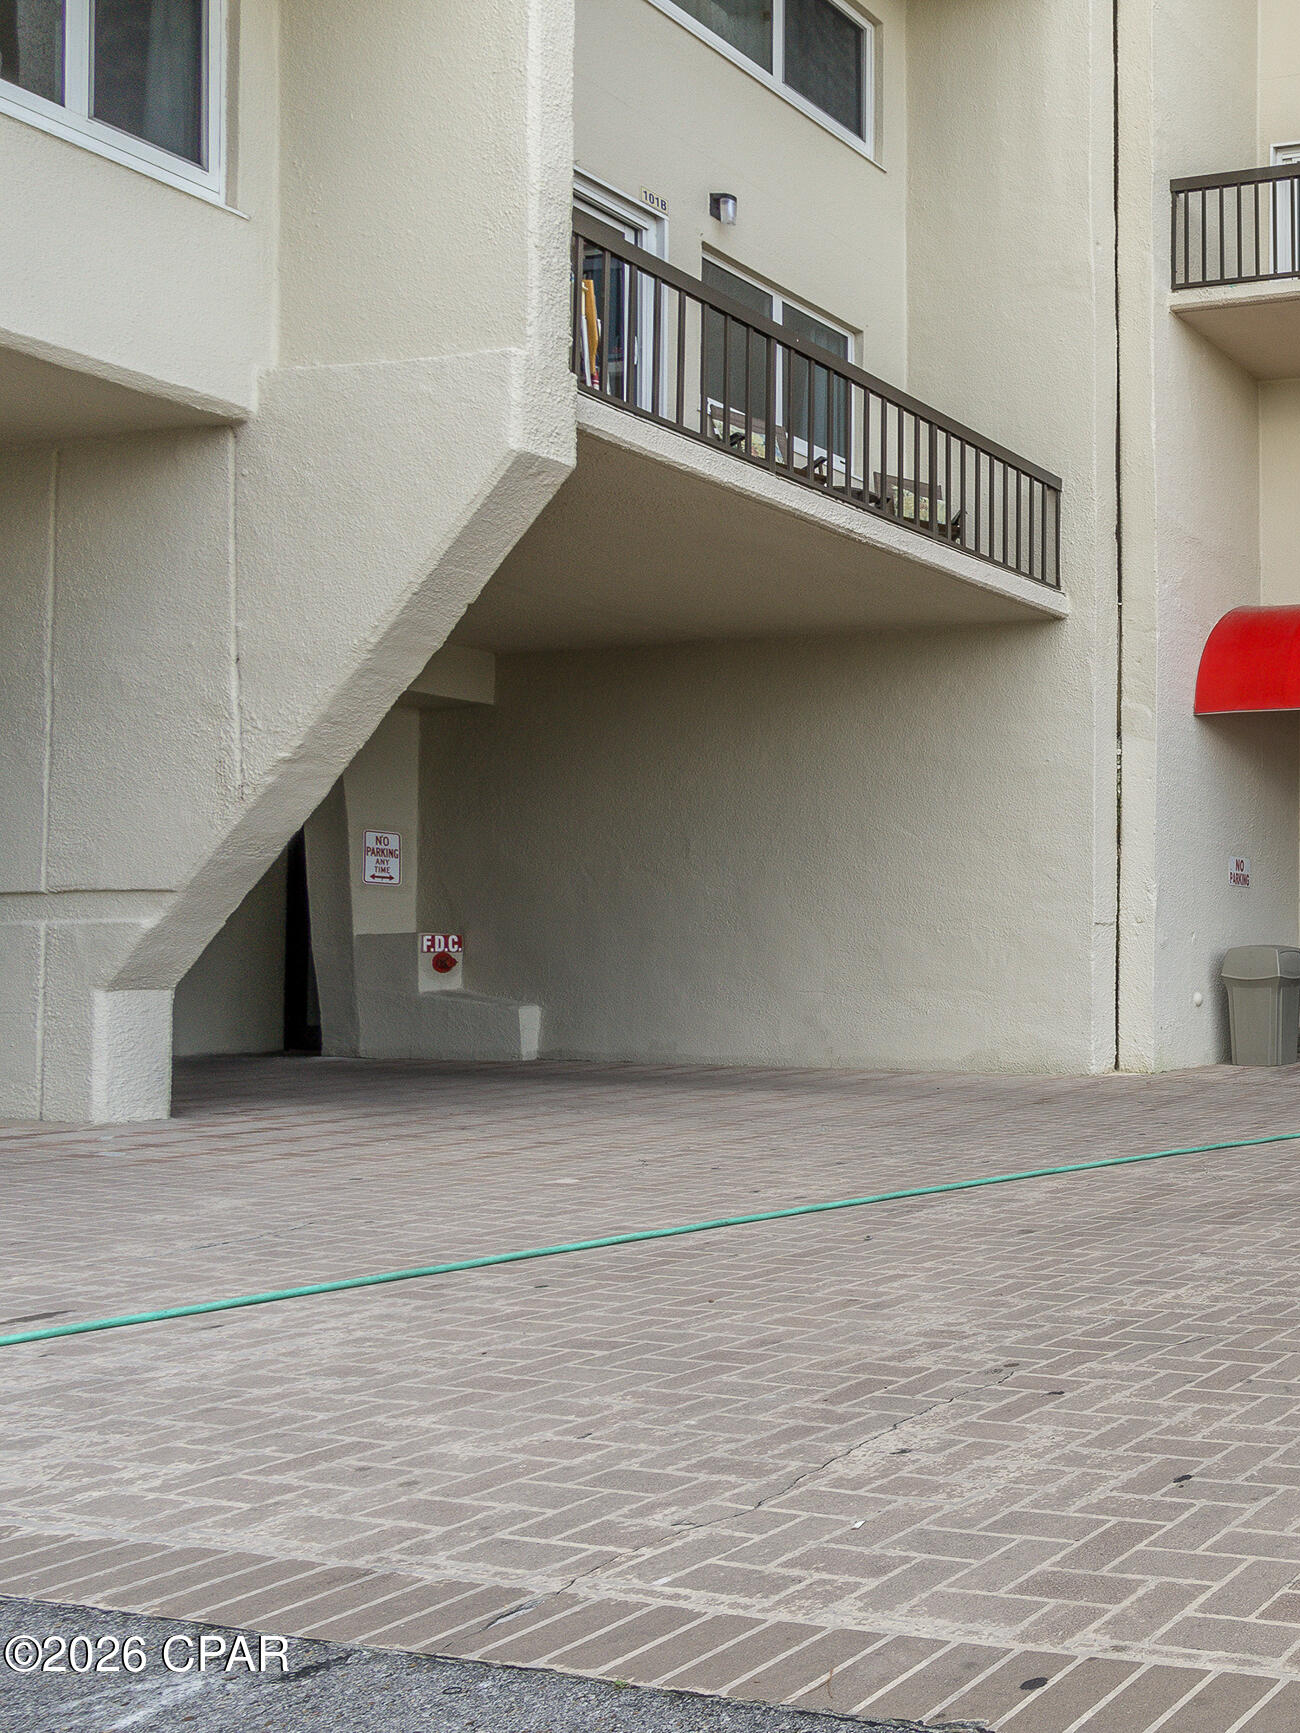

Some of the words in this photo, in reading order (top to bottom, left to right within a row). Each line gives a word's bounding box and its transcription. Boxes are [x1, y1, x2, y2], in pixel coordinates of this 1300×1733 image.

[643, 190, 667, 211] 101B
[375, 835, 390, 847] NO
[366, 846, 399, 859] PARKING
[375, 858, 390, 866] ANY
[1235, 858, 1245, 872] NO
[374, 866, 391, 874] TIME
[1229, 871, 1250, 887] PARKING
[422, 934, 462, 953] F.D.C.
